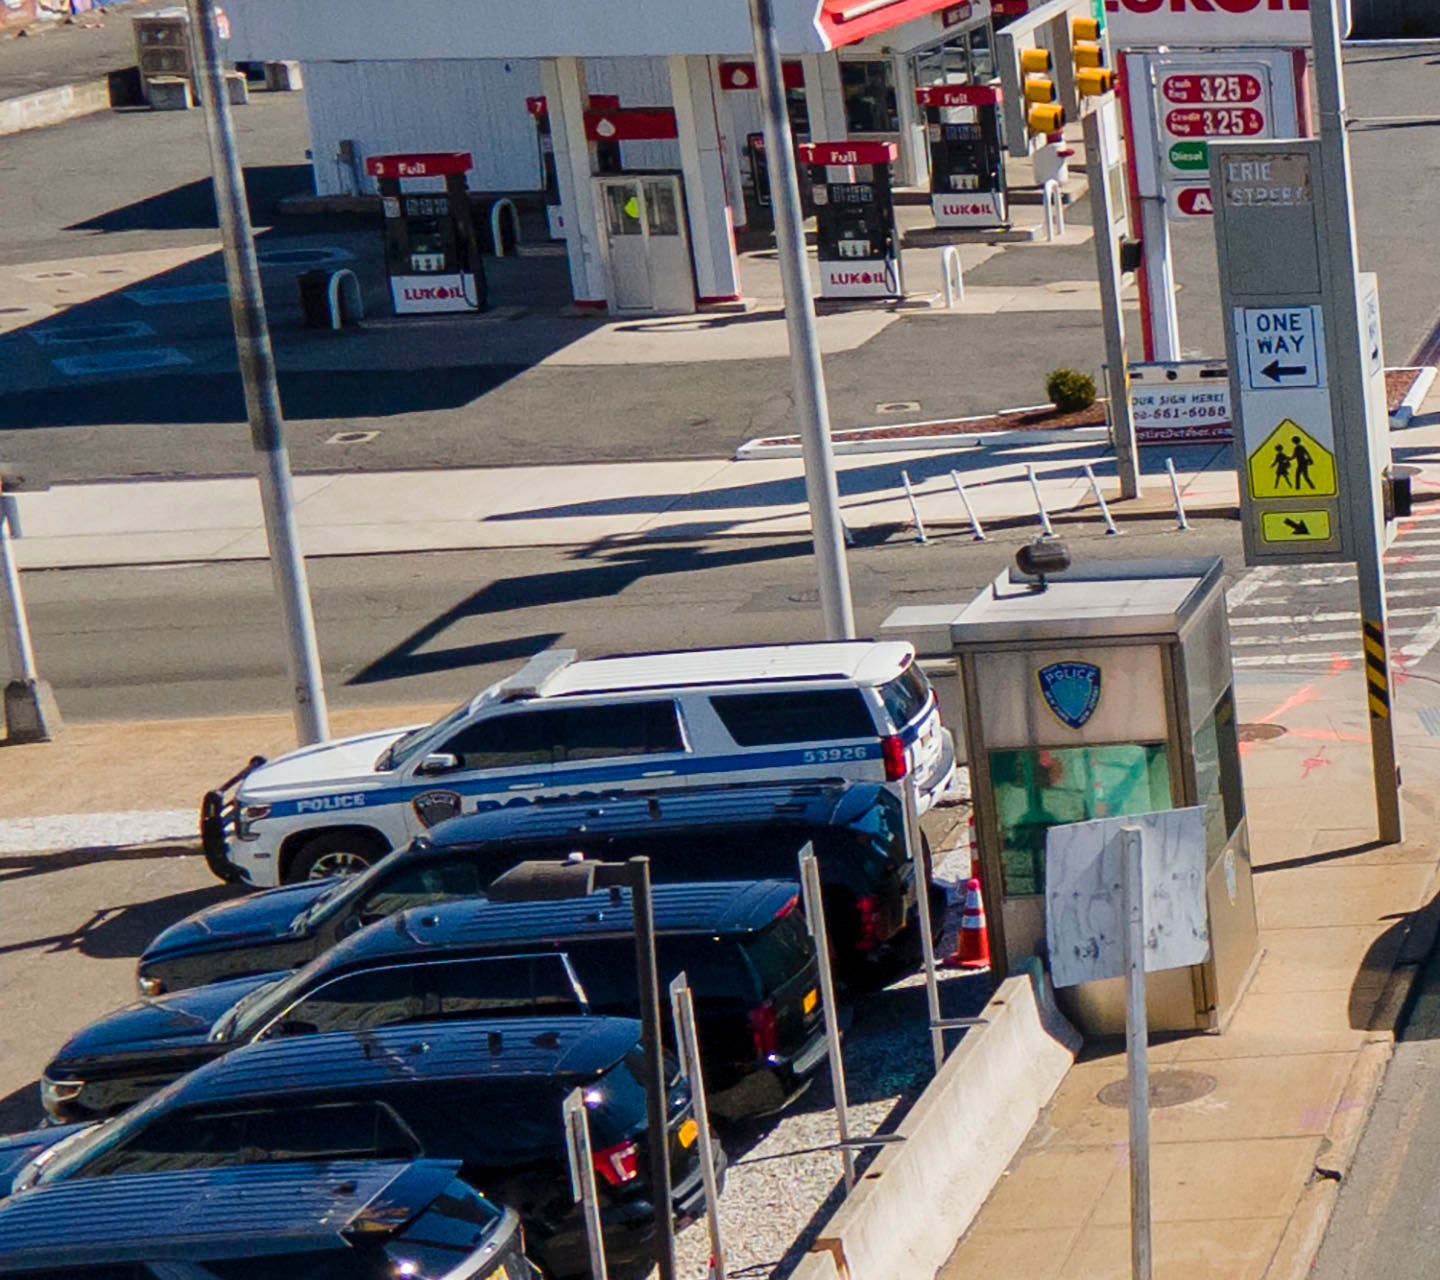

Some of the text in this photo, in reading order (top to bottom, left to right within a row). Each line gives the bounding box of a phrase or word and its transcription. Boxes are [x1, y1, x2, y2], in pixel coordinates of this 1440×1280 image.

[1168, 76, 1242, 102] Cash 3.25
[943, 93, 968, 104] Full
[1203, 111, 1244, 135] 3.25
[830, 151, 857, 163] Full
[1171, 150, 1203, 161] Diesel
[398, 163, 426, 175] Full
[1229, 162, 1272, 181] ERIE
[943, 204, 993, 216] LUKOIL
[831, 272, 886, 285] LUKOIL
[404, 285, 465, 301] LUKOIL
[1256, 313, 1302, 332] ONE
[1256, 334, 1305, 355] WAY
[1132, 393, 1225, 406] OUR SIGN HERE!
[1045, 669, 1095, 685] POLICE
[803, 747, 868, 763] 53926
[297, 793, 366, 814] POLICE
